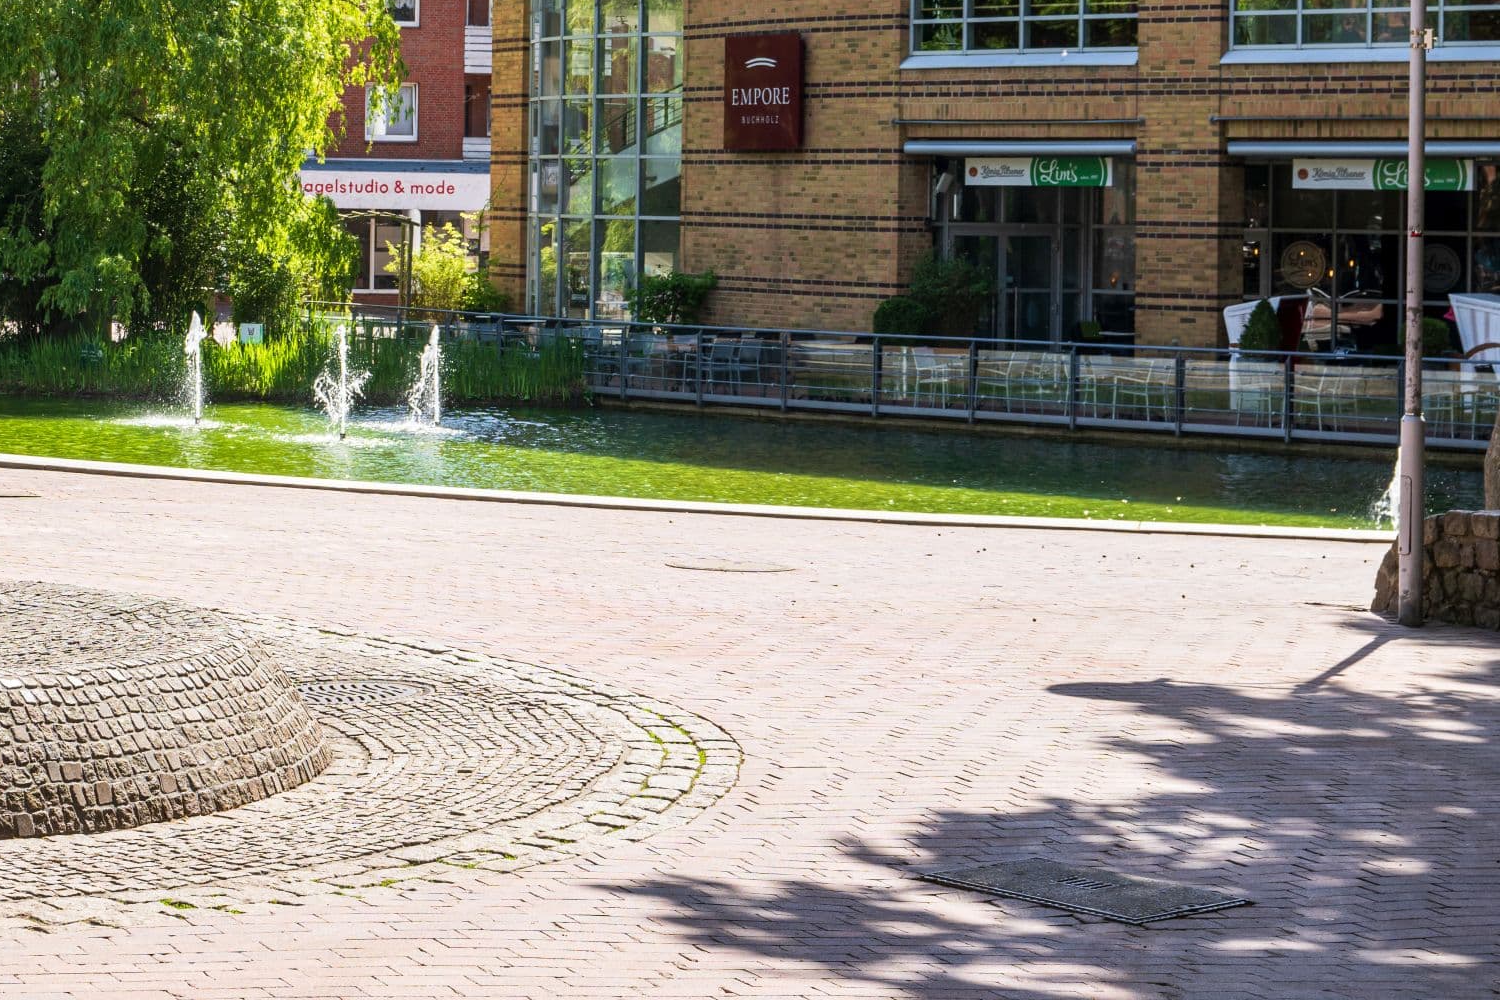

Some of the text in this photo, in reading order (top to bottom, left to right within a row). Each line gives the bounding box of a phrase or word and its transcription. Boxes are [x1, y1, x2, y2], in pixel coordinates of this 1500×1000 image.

[731, 87, 790, 105] EMPORE
[741, 115, 779, 124] BUCHHOLZ
[394, 180, 405, 194] &
[410, 179, 456, 195] mode
